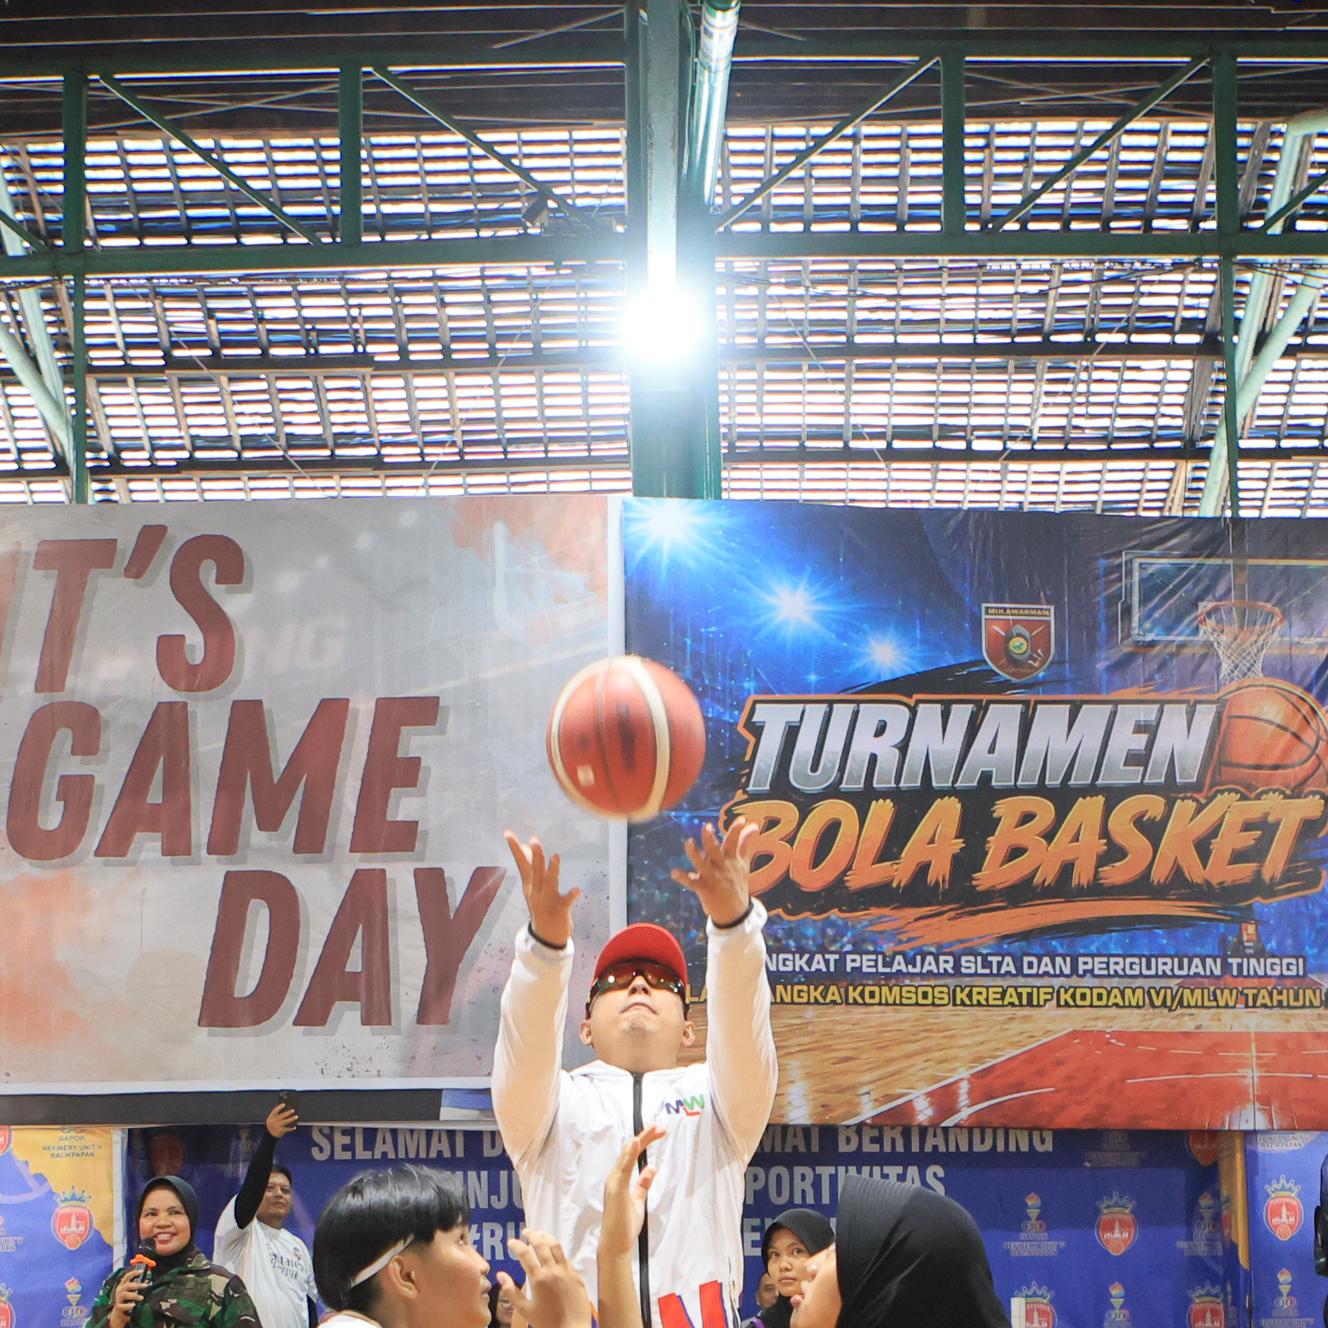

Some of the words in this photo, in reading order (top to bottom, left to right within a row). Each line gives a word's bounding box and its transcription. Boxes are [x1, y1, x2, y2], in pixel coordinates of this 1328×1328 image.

[5, 696, 441, 861] GAME
[746, 702, 1223, 794] TURNAMEN
[732, 796, 966, 896] BOLA
[971, 791, 1326, 893] BASKET
[197, 866, 507, 1028] DAY
[766, 953, 840, 974] NGKAT
[846, 953, 955, 975] PELAJAR
[961, 954, 1017, 975] SLTA
[1023, 955, 1071, 976] DAN
[1078, 956, 1222, 976] PERGURUAN
[1227, 957, 1305, 977] TINGGI
[848, 985, 949, 1006] KOMSOS
[956, 986, 1054, 1006] KREATIF
[1060, 987, 1144, 1007] KODAM
[1149, 987, 1239, 1010] VI/MLW
[1244, 988, 1322, 1007] TAHUN
